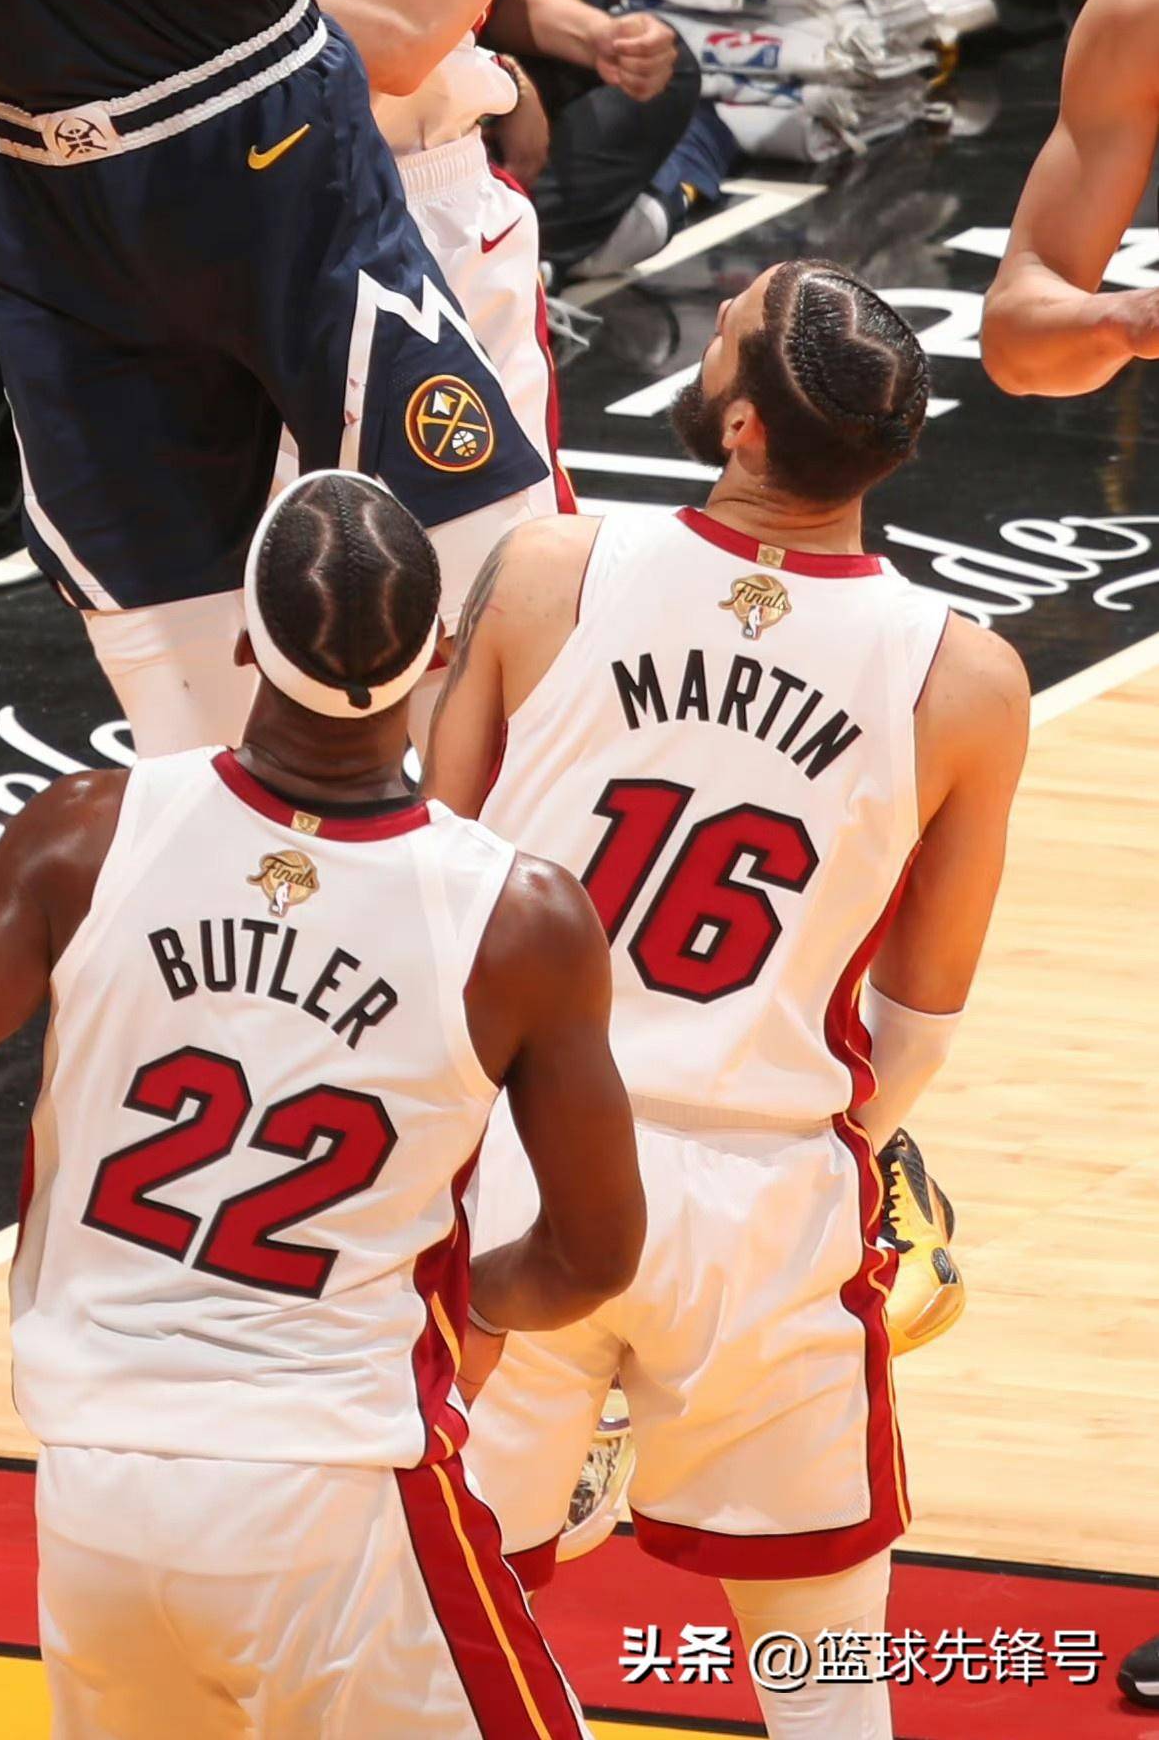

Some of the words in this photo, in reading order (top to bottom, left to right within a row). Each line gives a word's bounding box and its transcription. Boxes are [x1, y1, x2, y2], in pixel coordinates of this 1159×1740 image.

[720, 580, 790, 612] Finals
[611, 649, 864, 782] MARTIN
[247, 855, 319, 890] Finals
[581, 778, 820, 1004] 16
[147, 917, 398, 1051] BUTLER
[80, 1045, 399, 1301] 22
